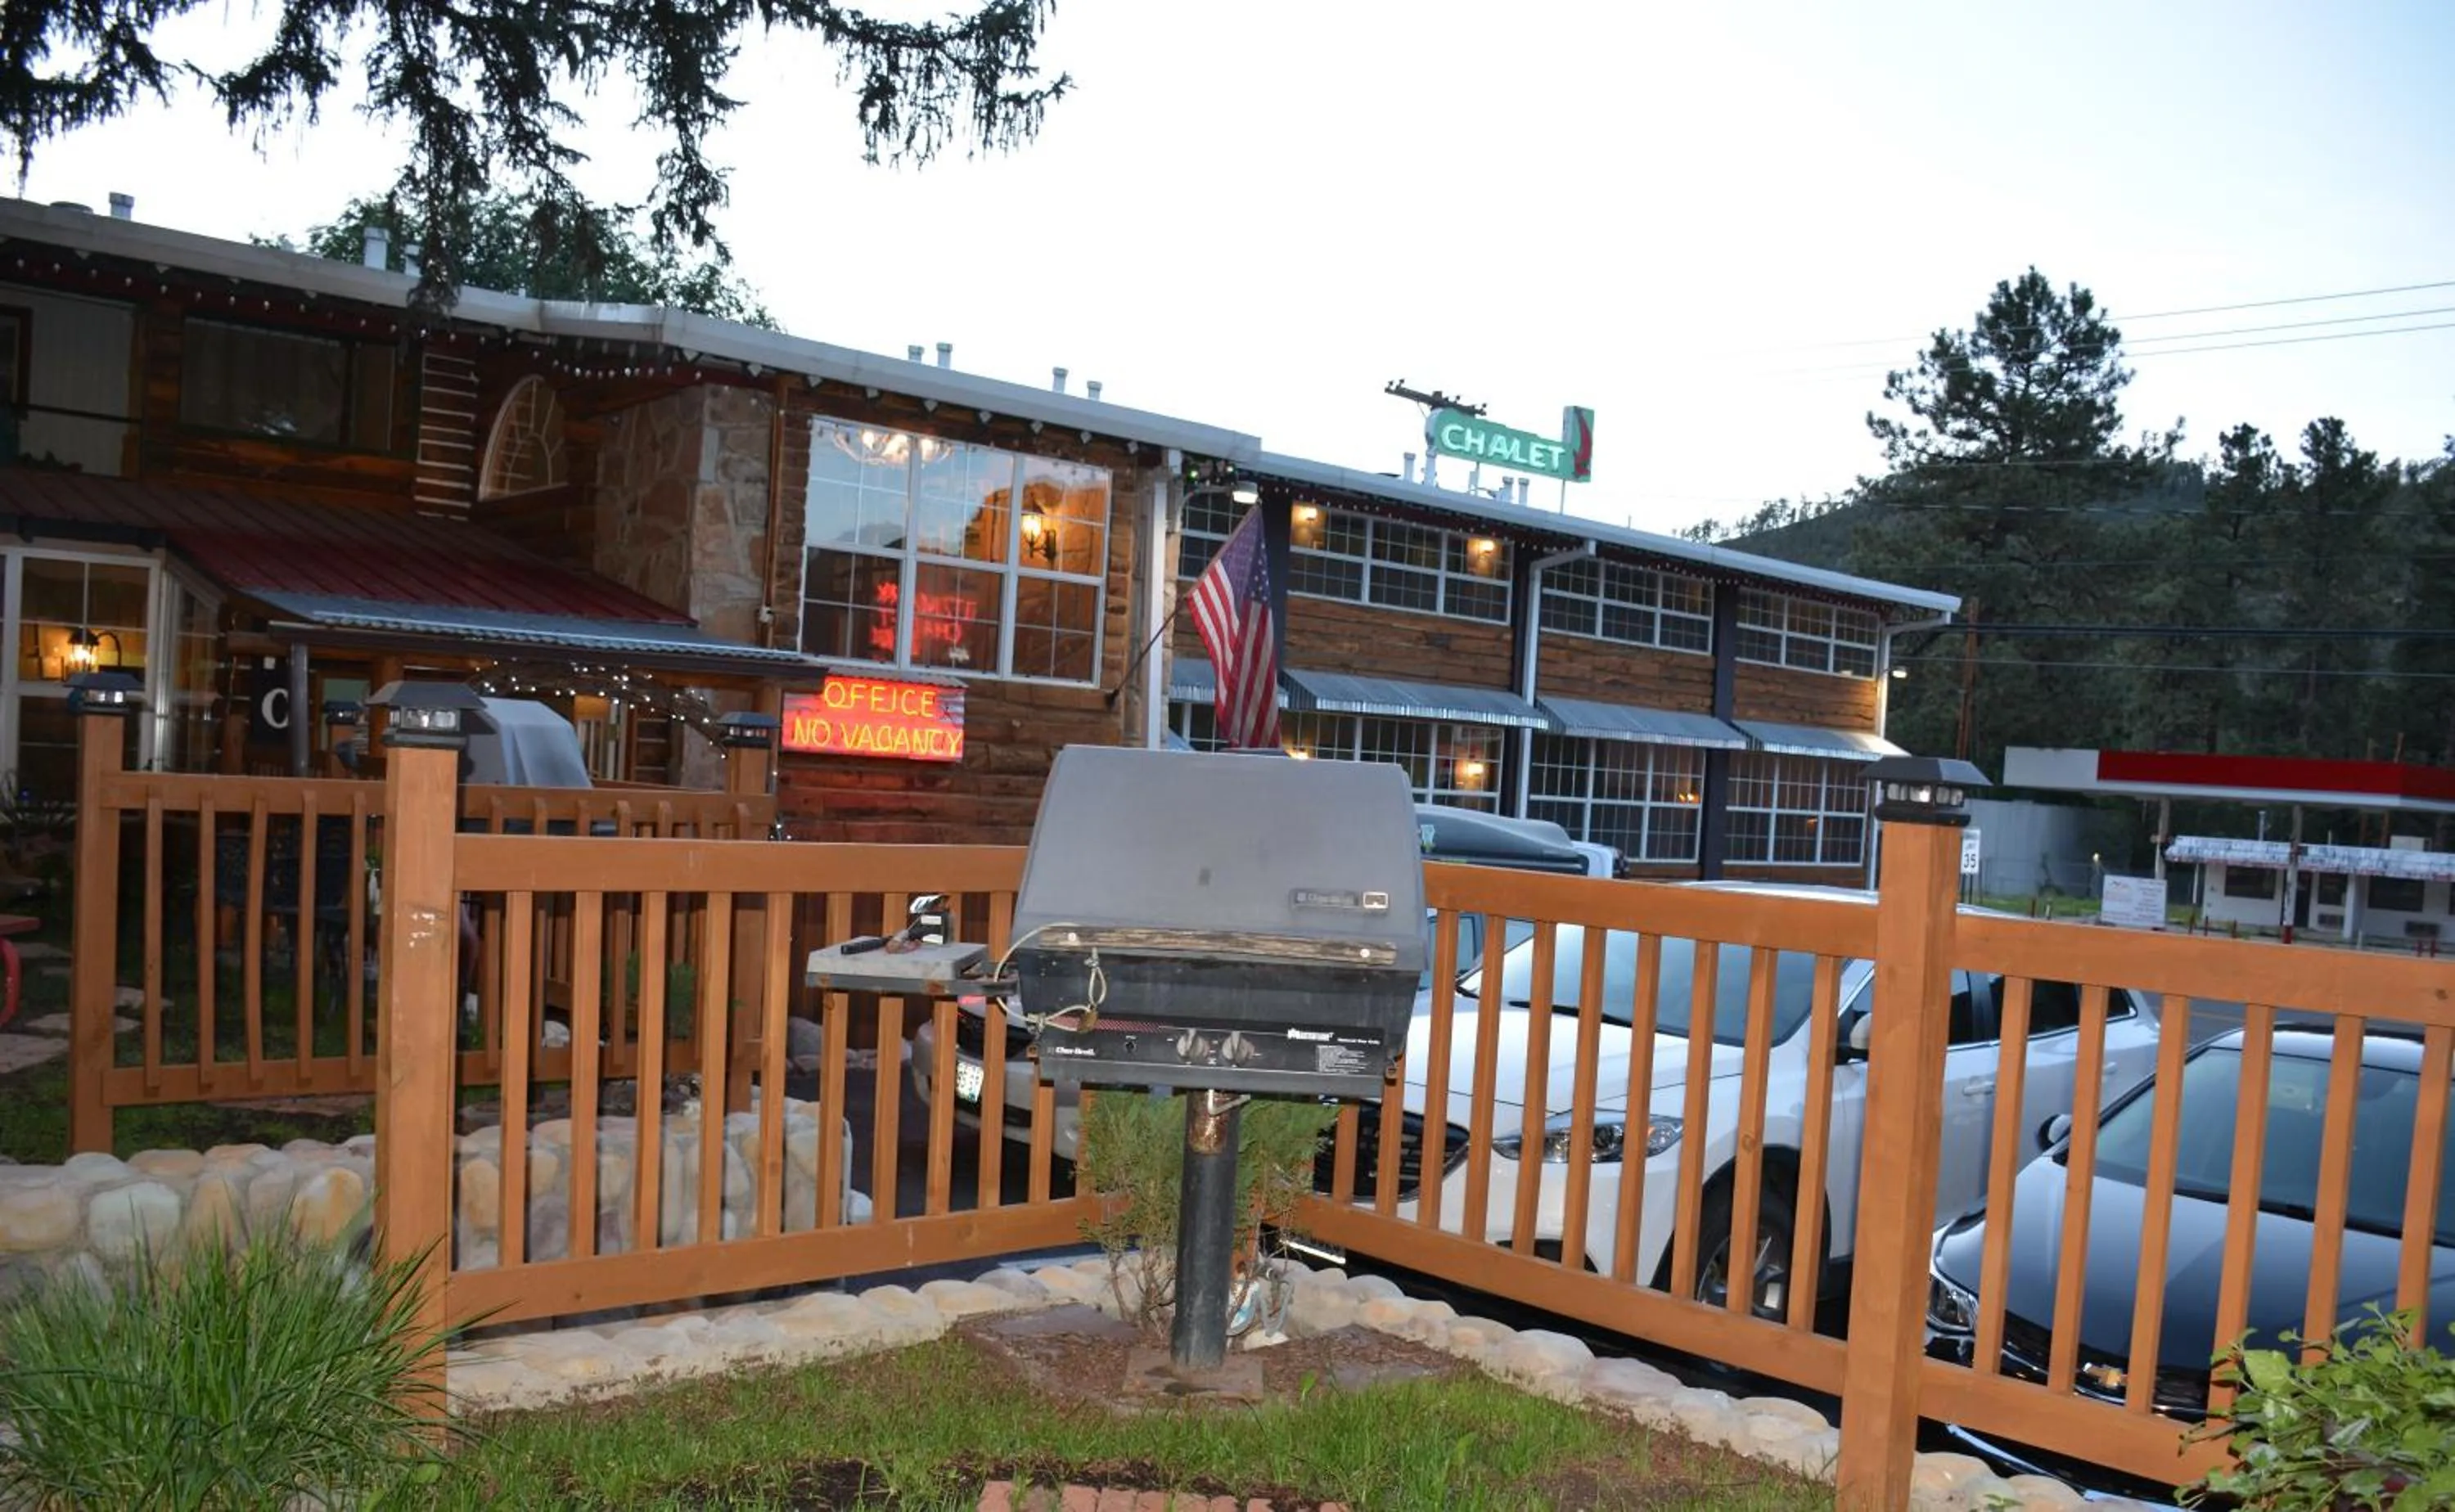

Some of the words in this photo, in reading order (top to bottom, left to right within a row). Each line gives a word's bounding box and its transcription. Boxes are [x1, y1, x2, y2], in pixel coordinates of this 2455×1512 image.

[1441, 424, 1565, 470] CHALET
[824, 682, 935, 717] OFFICE
[794, 717, 831, 746] NO
[841, 723, 962, 756] VACANCY
[1963, 853, 1976, 869] 35
